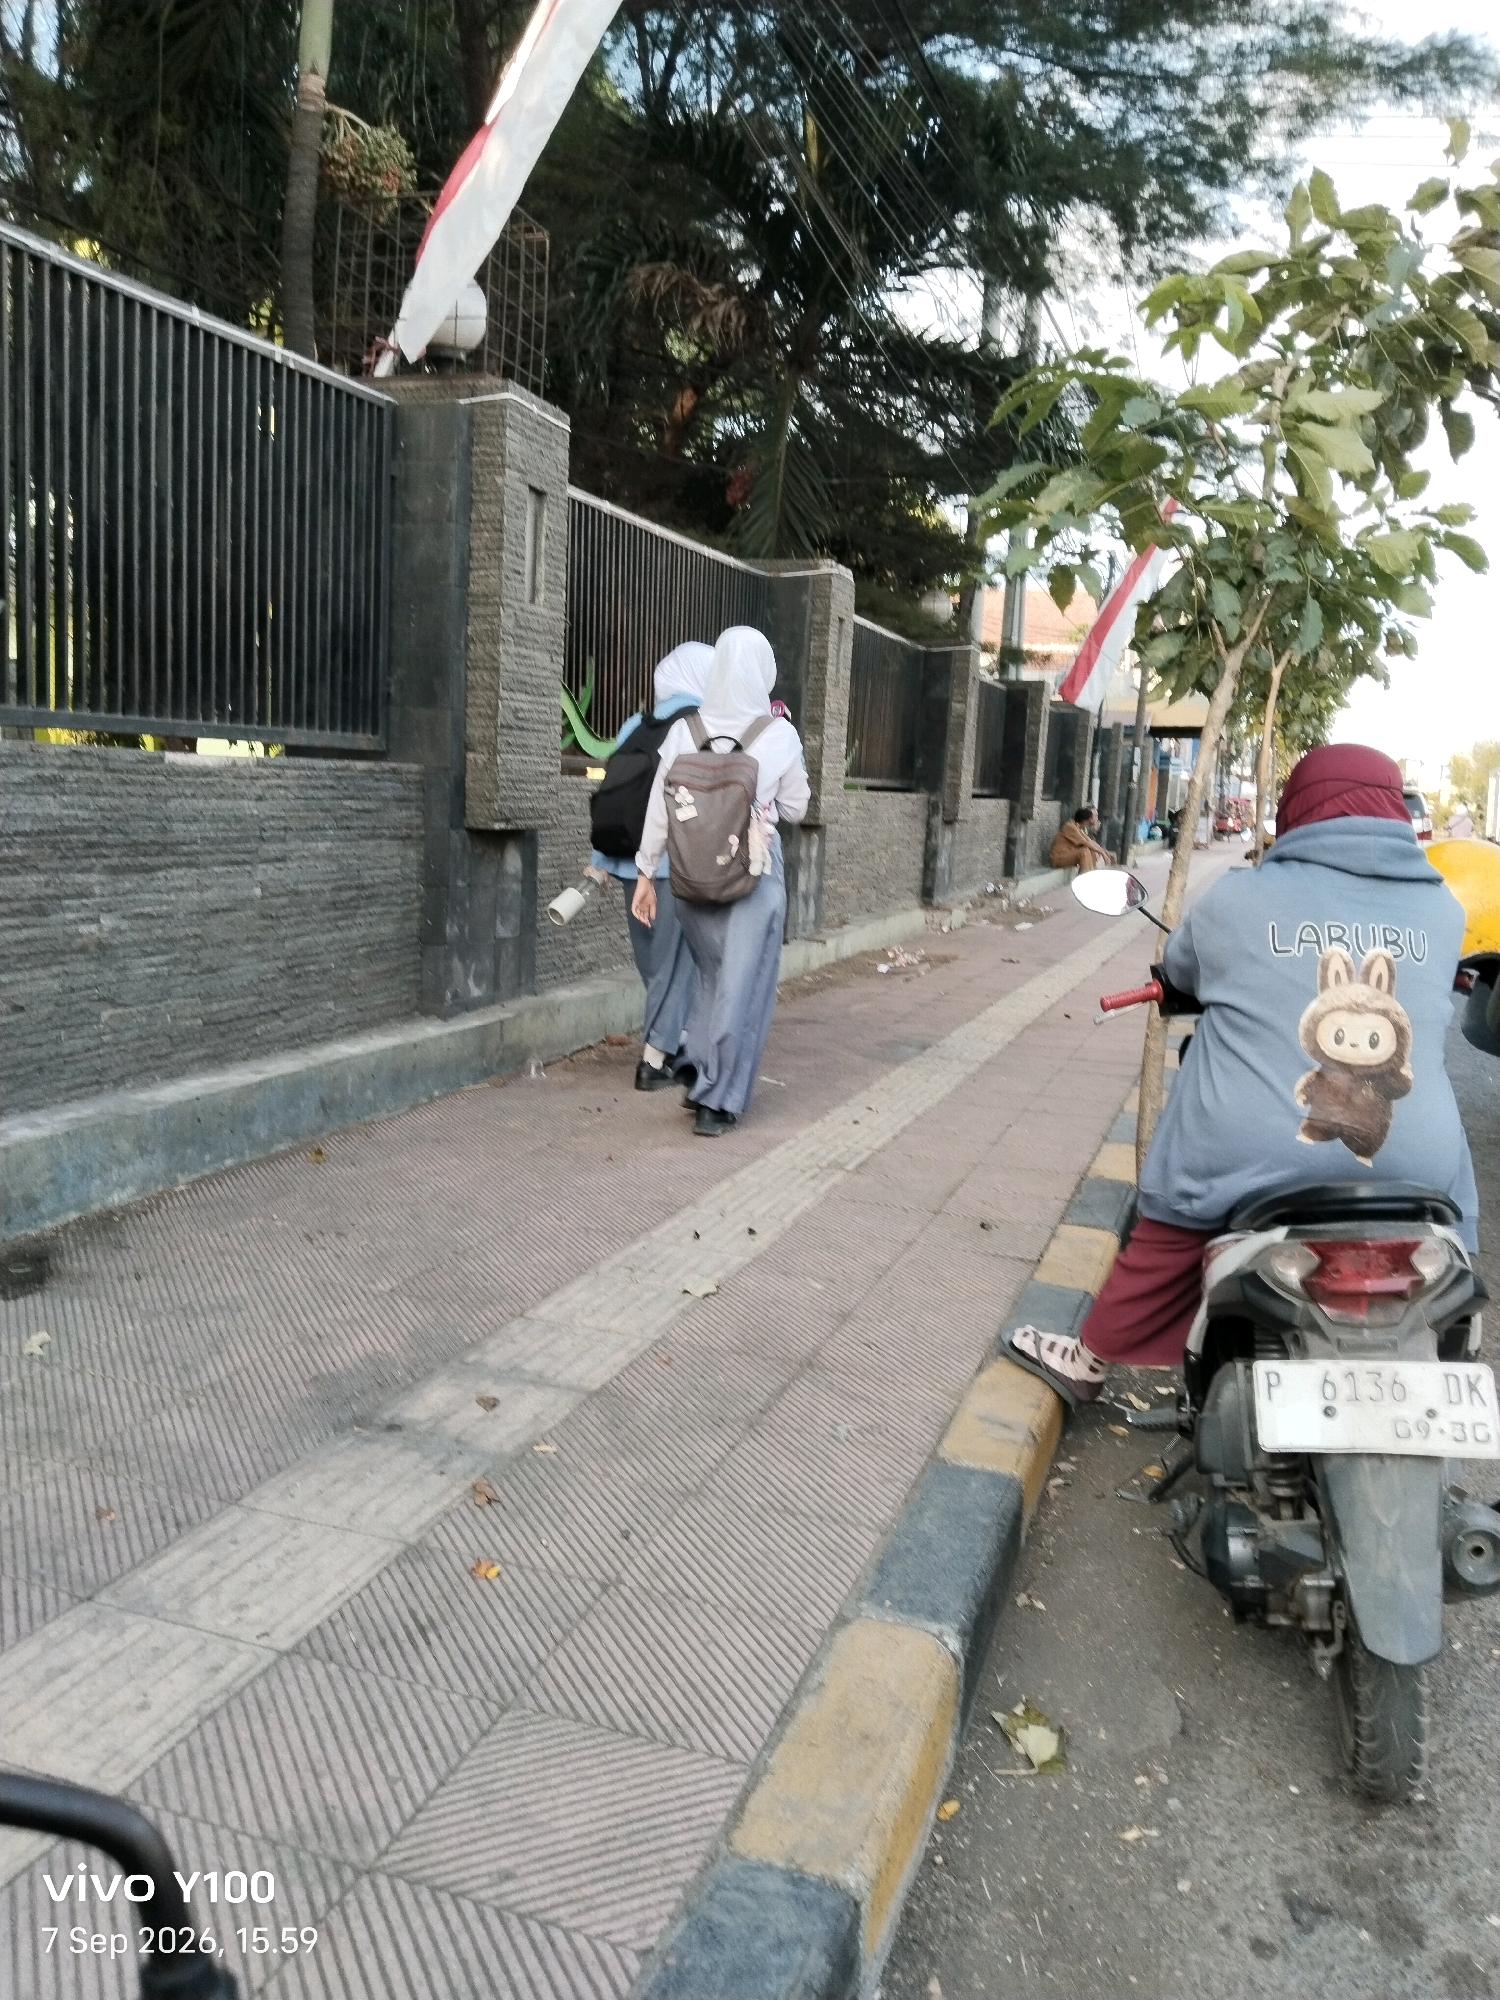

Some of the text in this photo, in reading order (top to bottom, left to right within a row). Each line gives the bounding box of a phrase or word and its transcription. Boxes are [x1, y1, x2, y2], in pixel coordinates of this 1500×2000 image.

[1269, 921, 1428, 966] LABUBU
[1265, 1370, 1489, 1407] P 6136 DK
